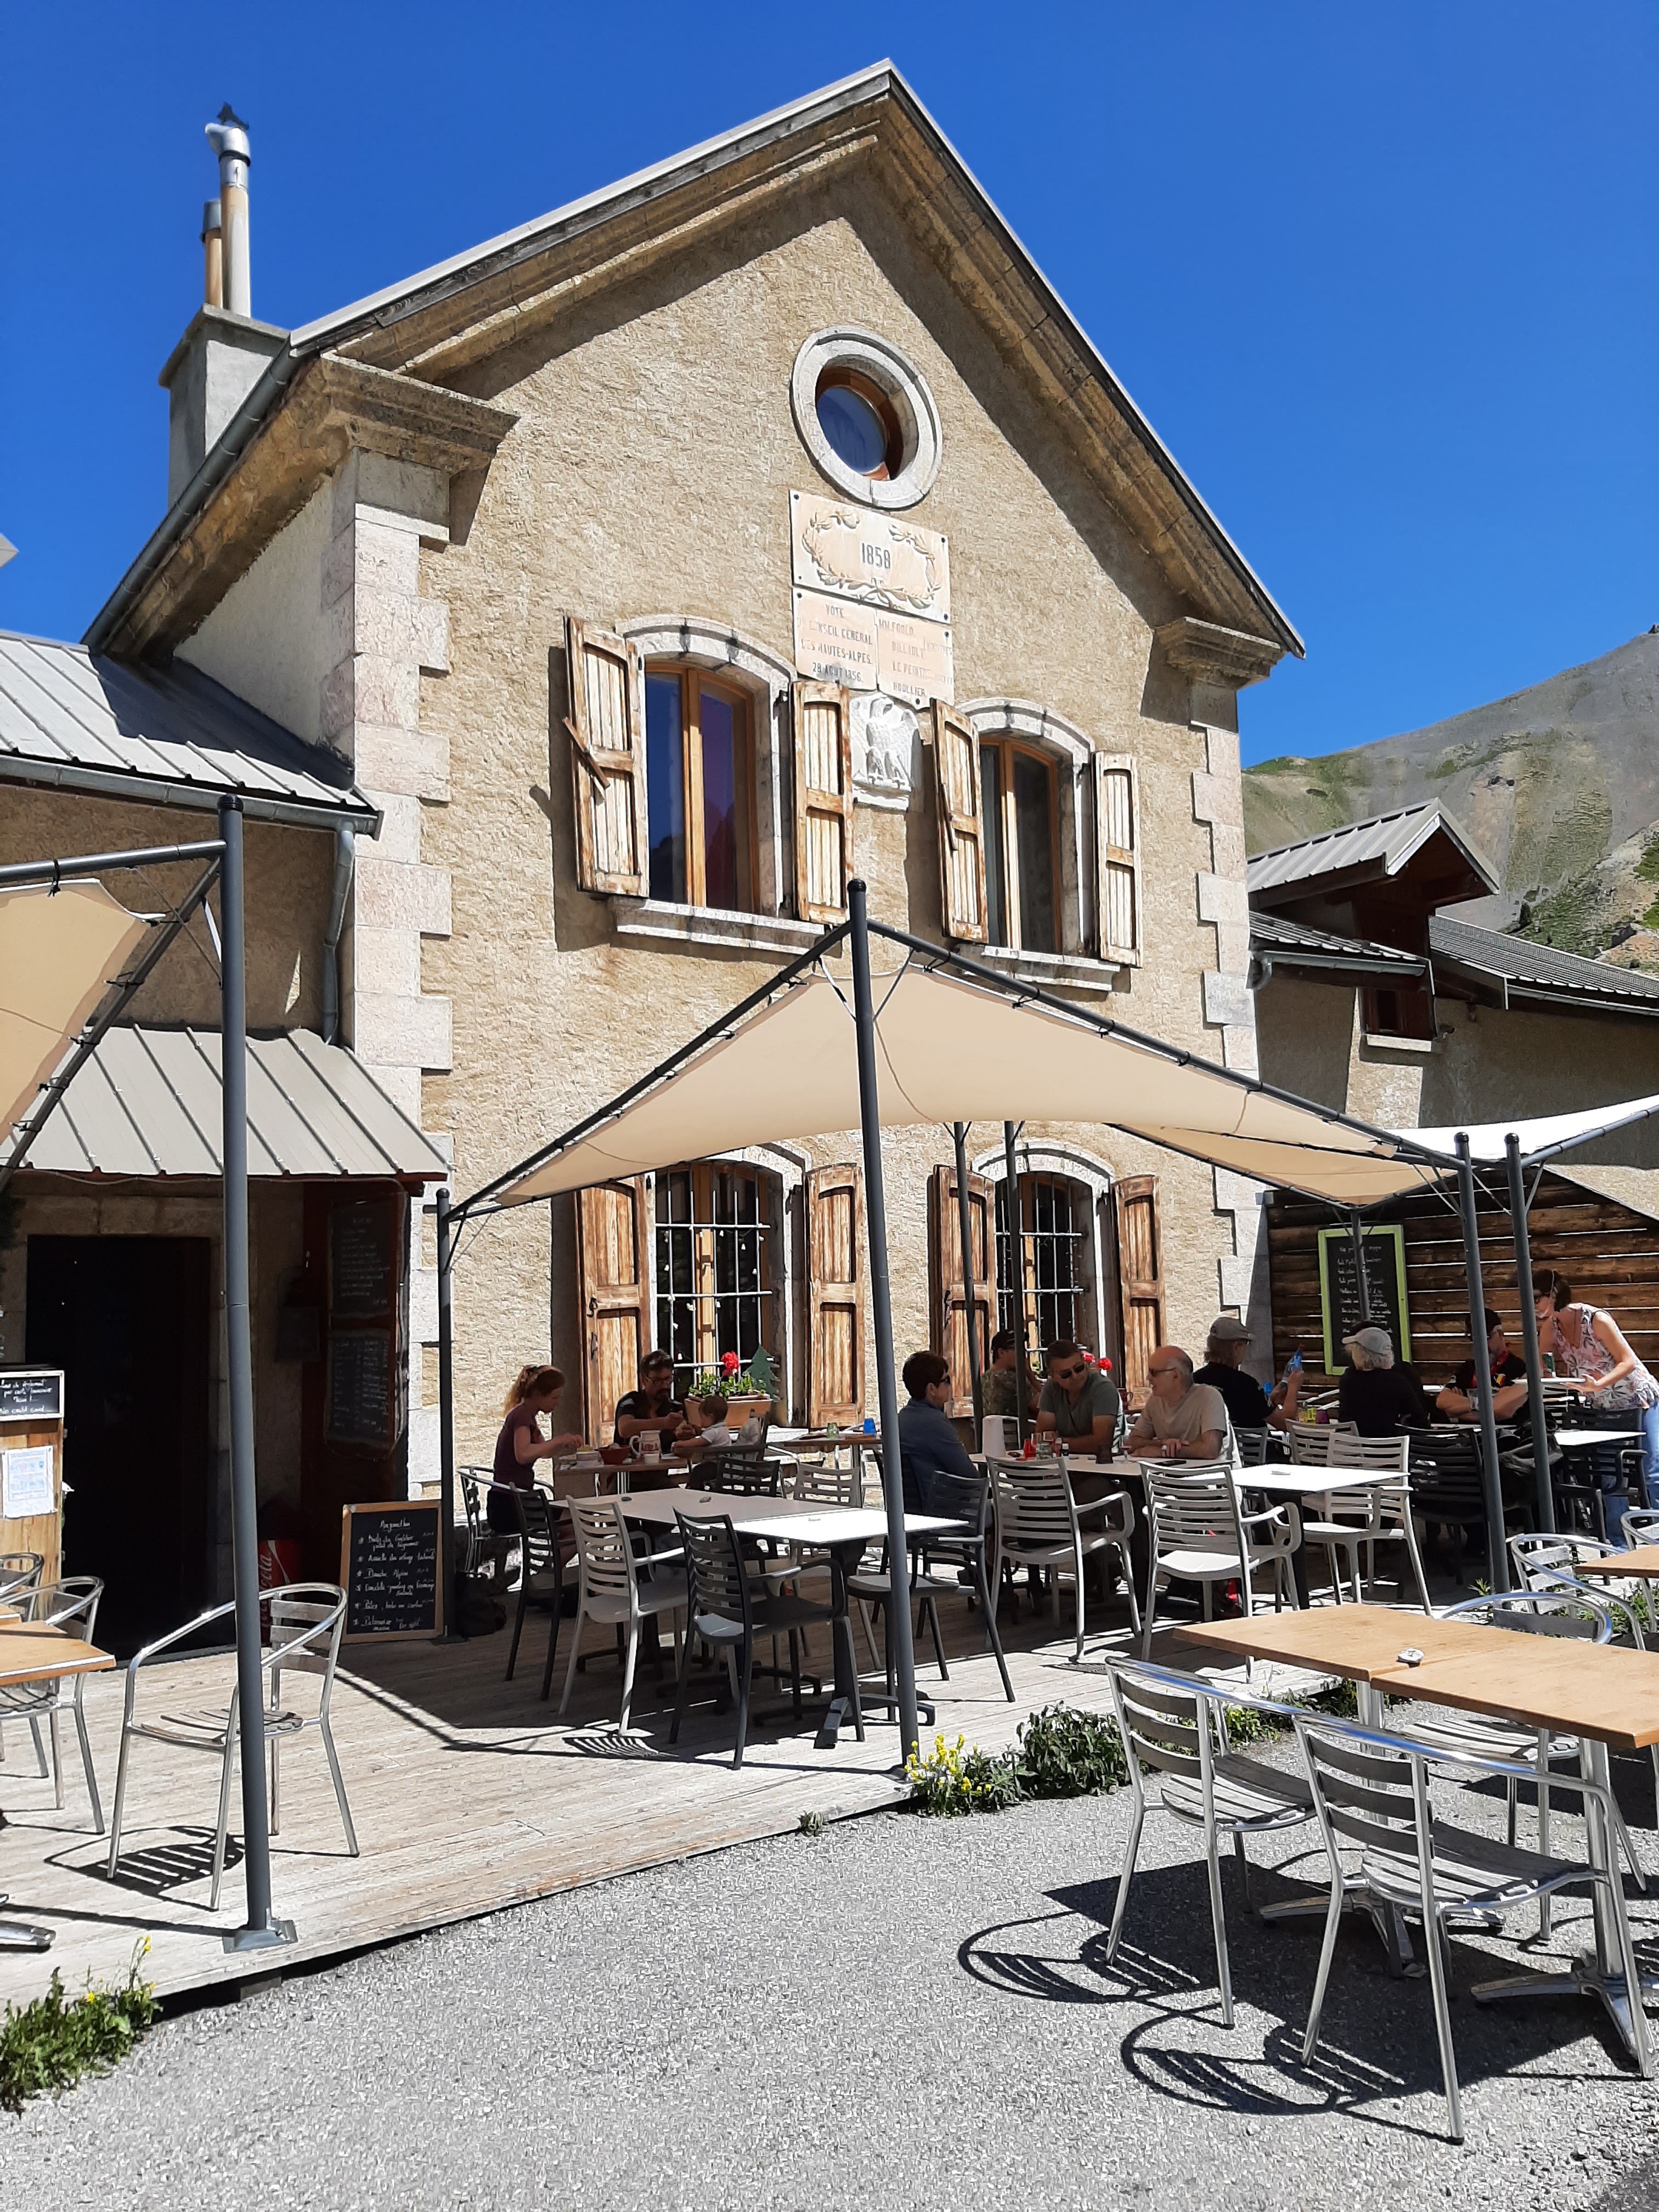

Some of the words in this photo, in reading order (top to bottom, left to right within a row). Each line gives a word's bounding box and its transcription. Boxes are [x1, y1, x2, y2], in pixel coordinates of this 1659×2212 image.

[862, 543, 890, 569] 1858
[825, 604, 845, 618] VOTE
[812, 662, 822, 674] 28
